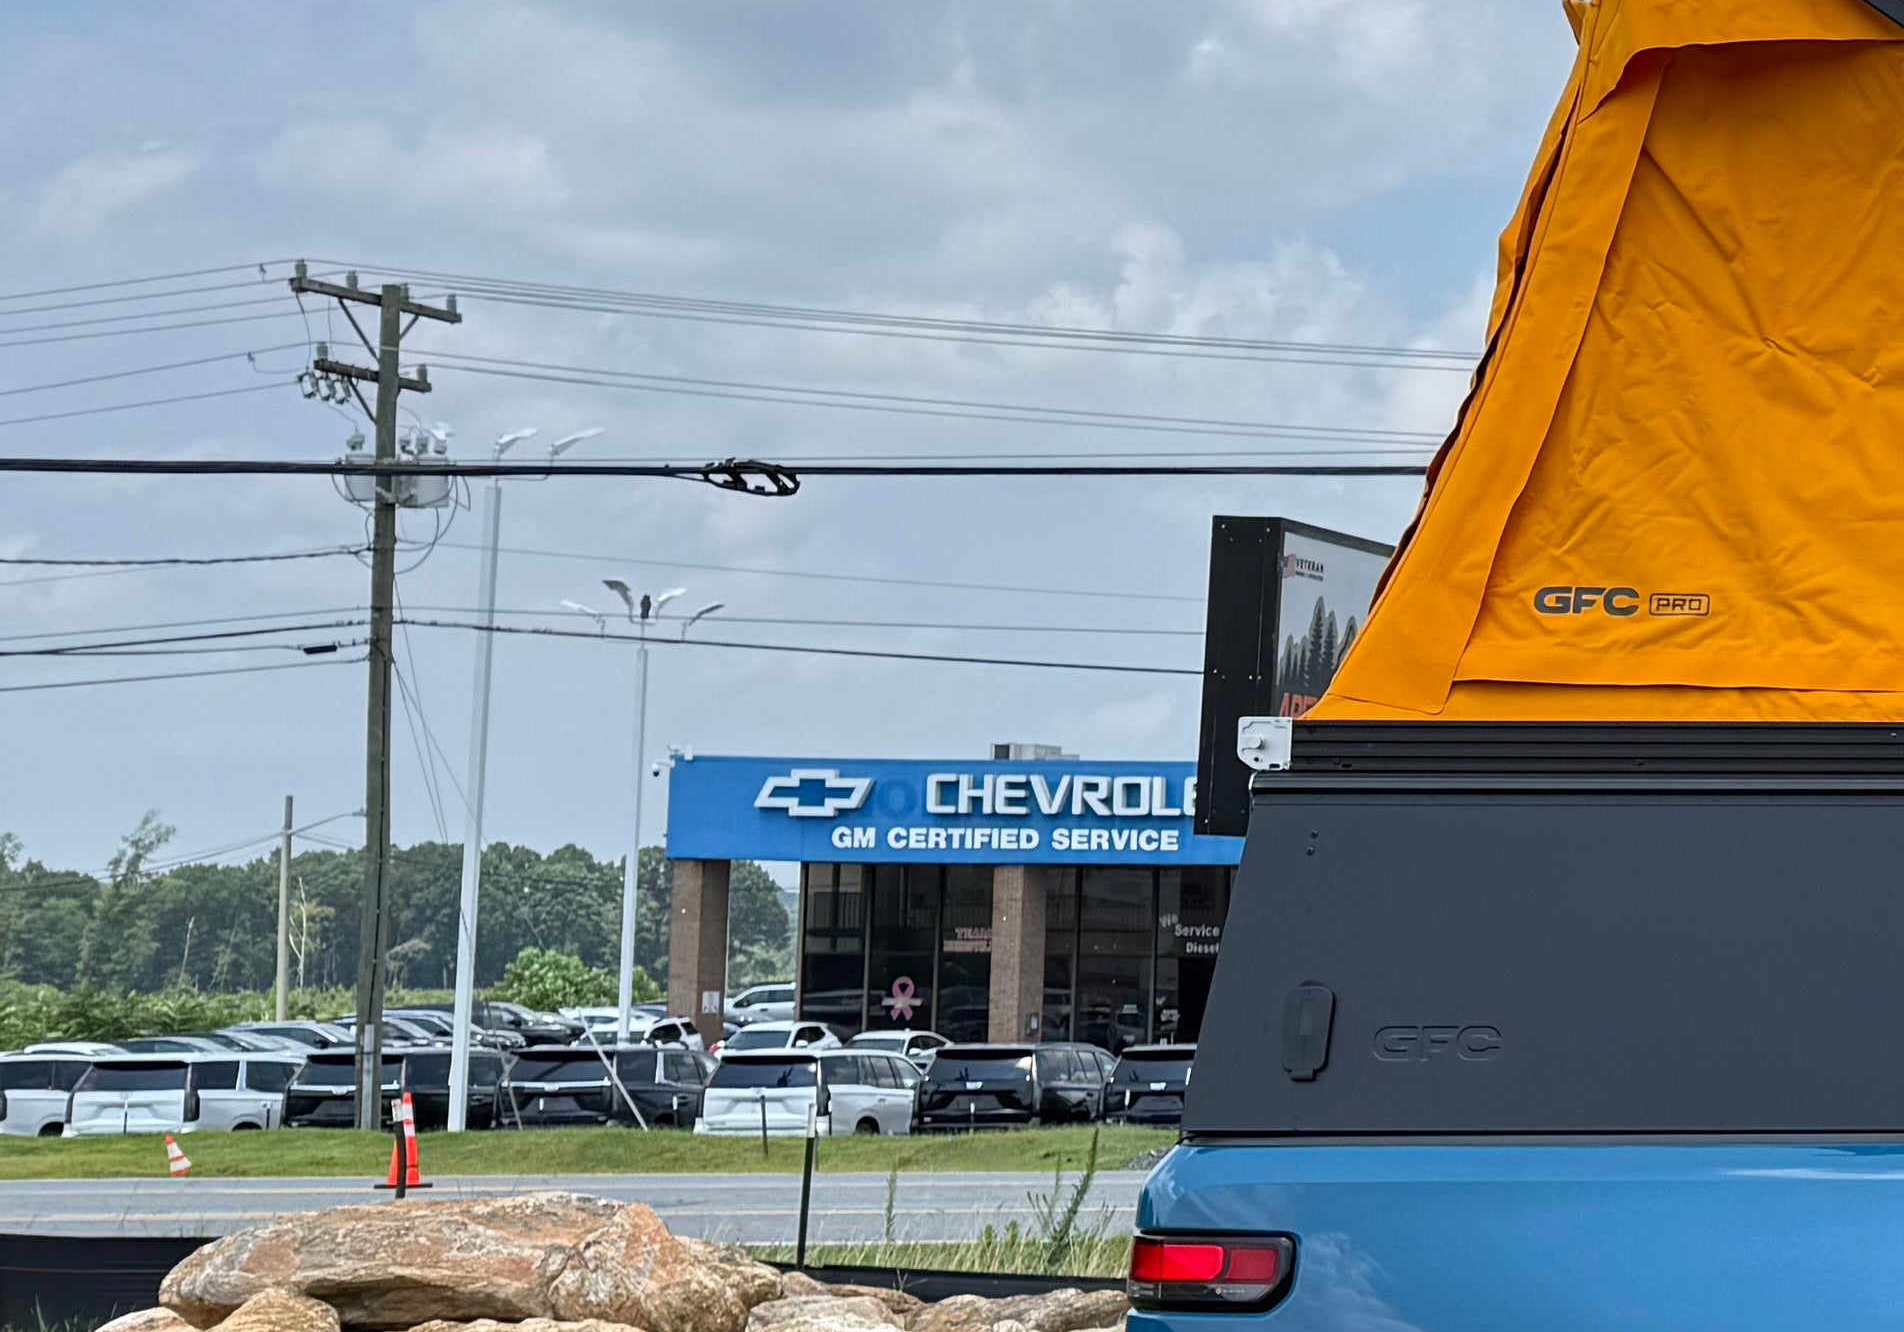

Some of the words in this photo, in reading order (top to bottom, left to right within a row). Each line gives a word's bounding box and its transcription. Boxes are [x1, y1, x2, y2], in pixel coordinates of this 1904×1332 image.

[1533, 585, 1640, 616] GFC
[1655, 597, 1702, 612] PRO
[831, 826, 876, 849] GM
[887, 827, 1040, 851] CERTIFIED
[1051, 828, 1180, 852] SERVICE
[1174, 923, 1220, 938] Service
[1373, 1025, 1501, 1062] GFC
